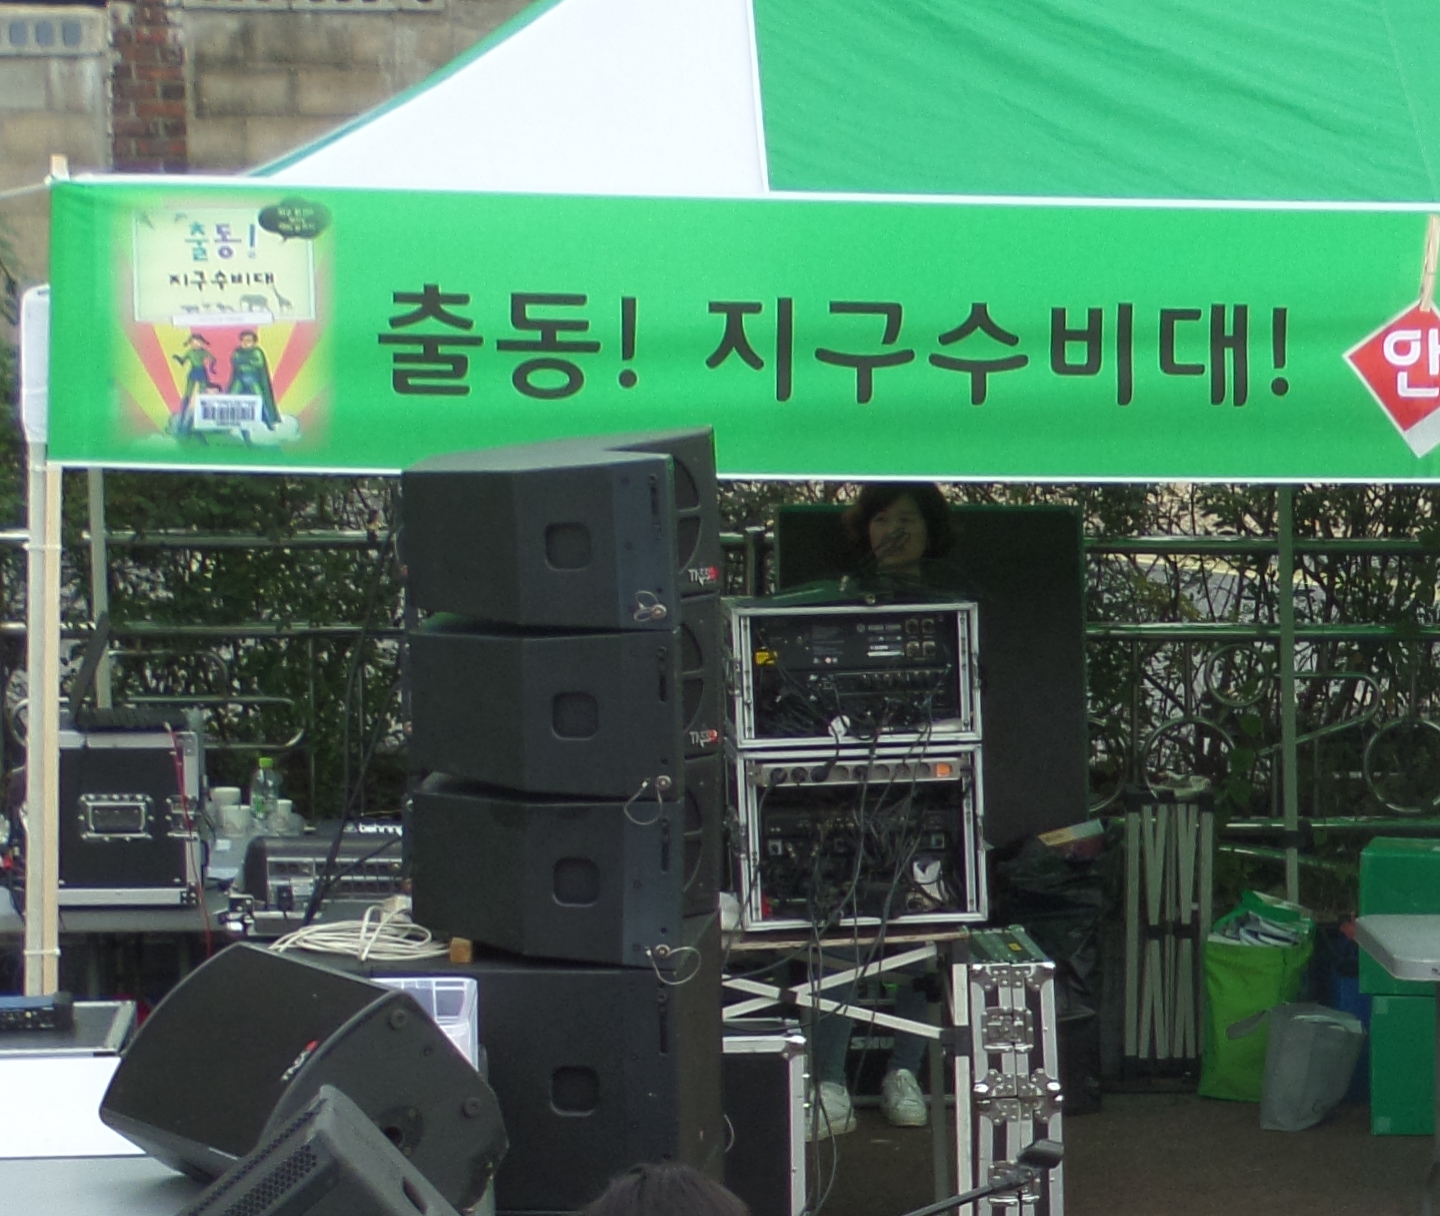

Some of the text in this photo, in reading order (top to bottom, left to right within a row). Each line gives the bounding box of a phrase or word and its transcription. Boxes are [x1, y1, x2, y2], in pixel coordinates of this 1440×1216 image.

[185, 221, 258, 261] 출동!
[169, 270, 275, 292] 지구수비대
[376, 283, 1290, 407] 출동! 지구수비대!
